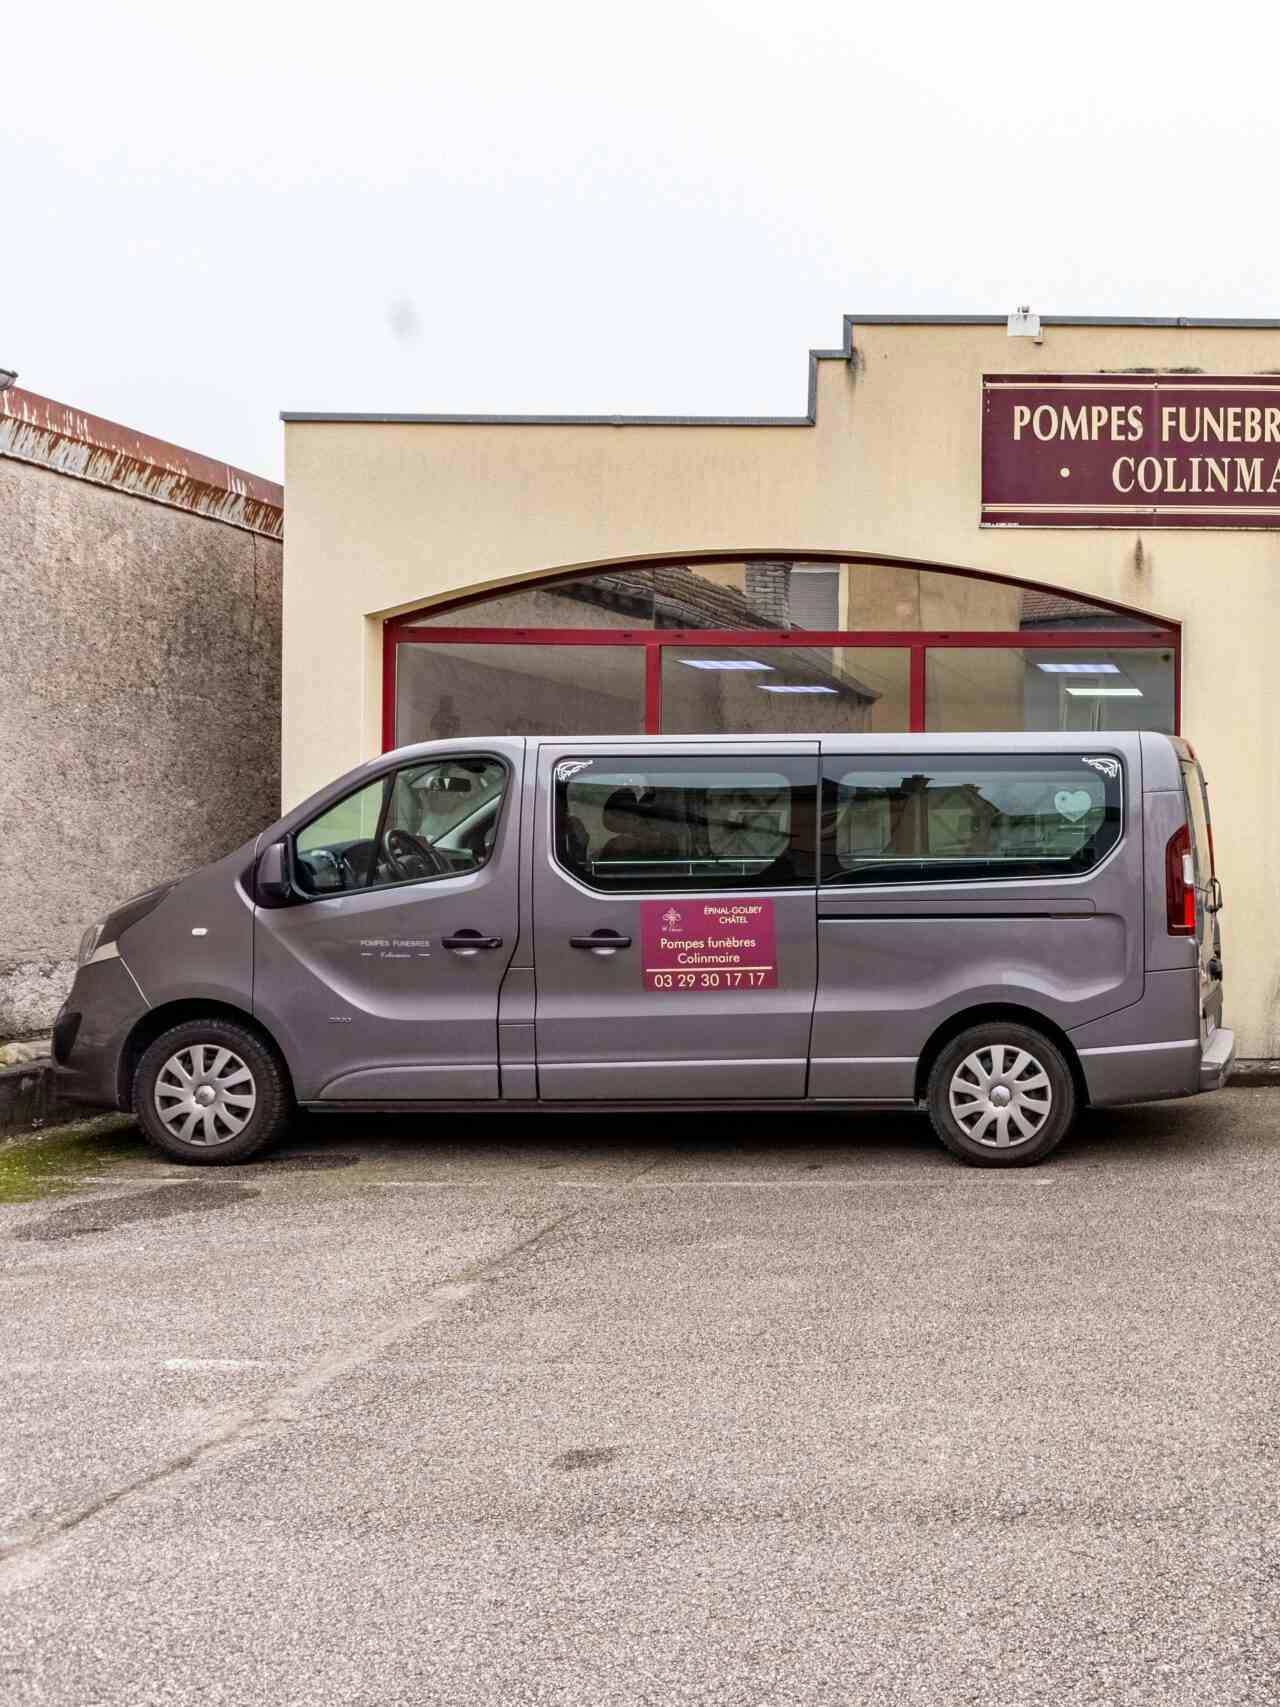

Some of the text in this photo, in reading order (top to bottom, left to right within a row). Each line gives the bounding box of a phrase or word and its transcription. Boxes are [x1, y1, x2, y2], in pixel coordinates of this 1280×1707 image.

[1013, 405, 1144, 441] POMPES
[719, 914, 748, 924] CHÂTEL
[660, 936, 756, 951] Pompes funèbres
[677, 953, 740, 965] Colinmaire
[654, 972, 765, 988] 03 29 30 17 17
